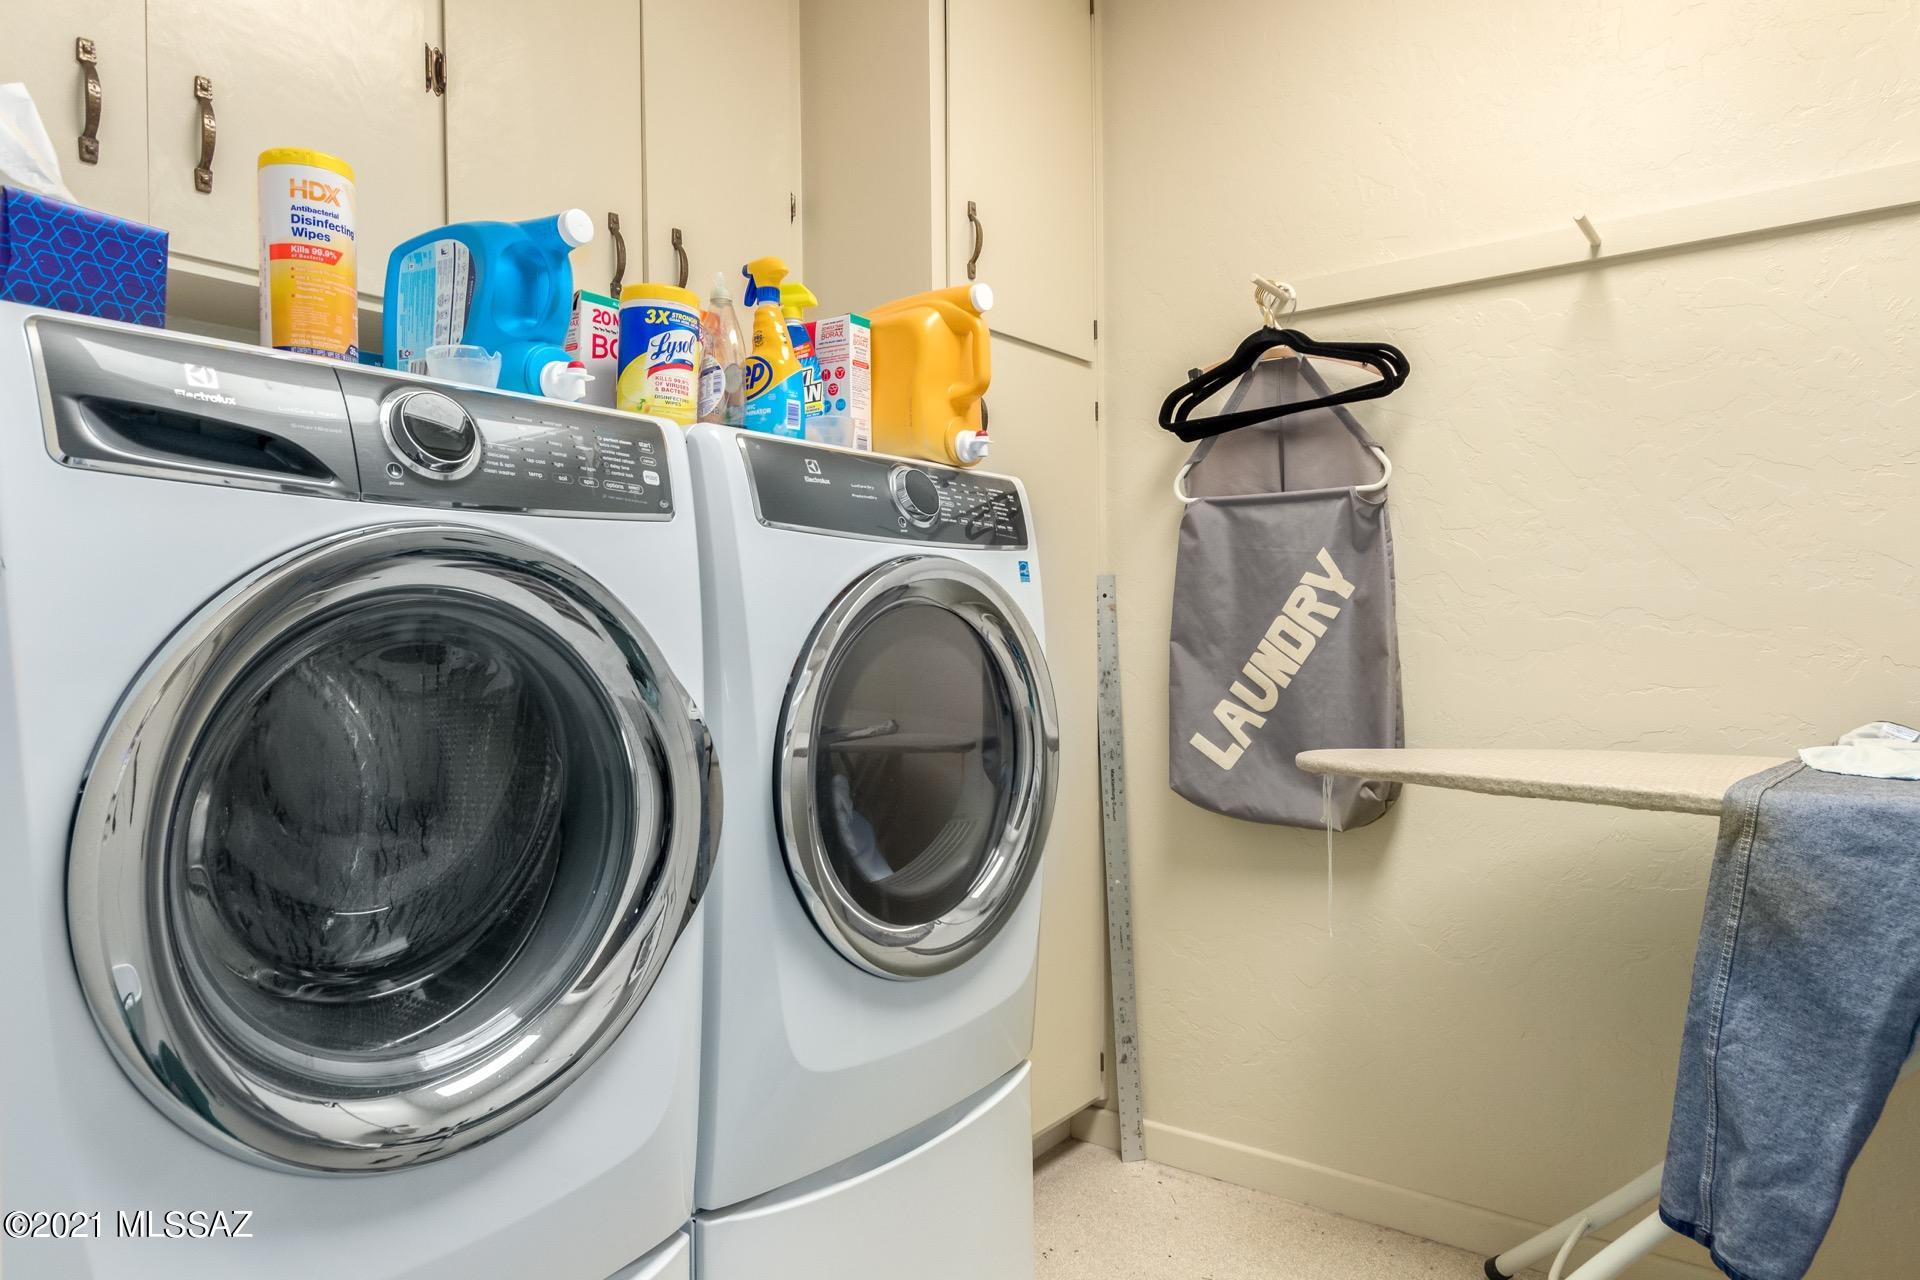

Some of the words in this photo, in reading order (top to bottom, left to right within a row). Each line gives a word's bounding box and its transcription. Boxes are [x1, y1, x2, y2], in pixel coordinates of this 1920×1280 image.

[289, 178, 341, 207] HDX
[291, 204, 340, 220] Antibacterial
[290, 213, 355, 241] Disinfecting
[291, 226, 332, 242] Wipes
[290, 244, 310, 254] Kills
[311, 247, 337, 260] 99.9%
[592, 308, 611, 326] 20
[644, 308, 671, 325] 3X
[821, 331, 844, 341] BORAX
[650, 332, 696, 362] Lysol
[745, 363, 765, 390] ep
[661, 386, 689, 397] BACTERIA
[665, 382, 690, 392] VIRUSES
[174, 389, 237, 405] Electrolux
[528, 470, 543, 479] temp
[605, 482, 625, 491] options
[1189, 547, 1355, 770] LAUNDRY
